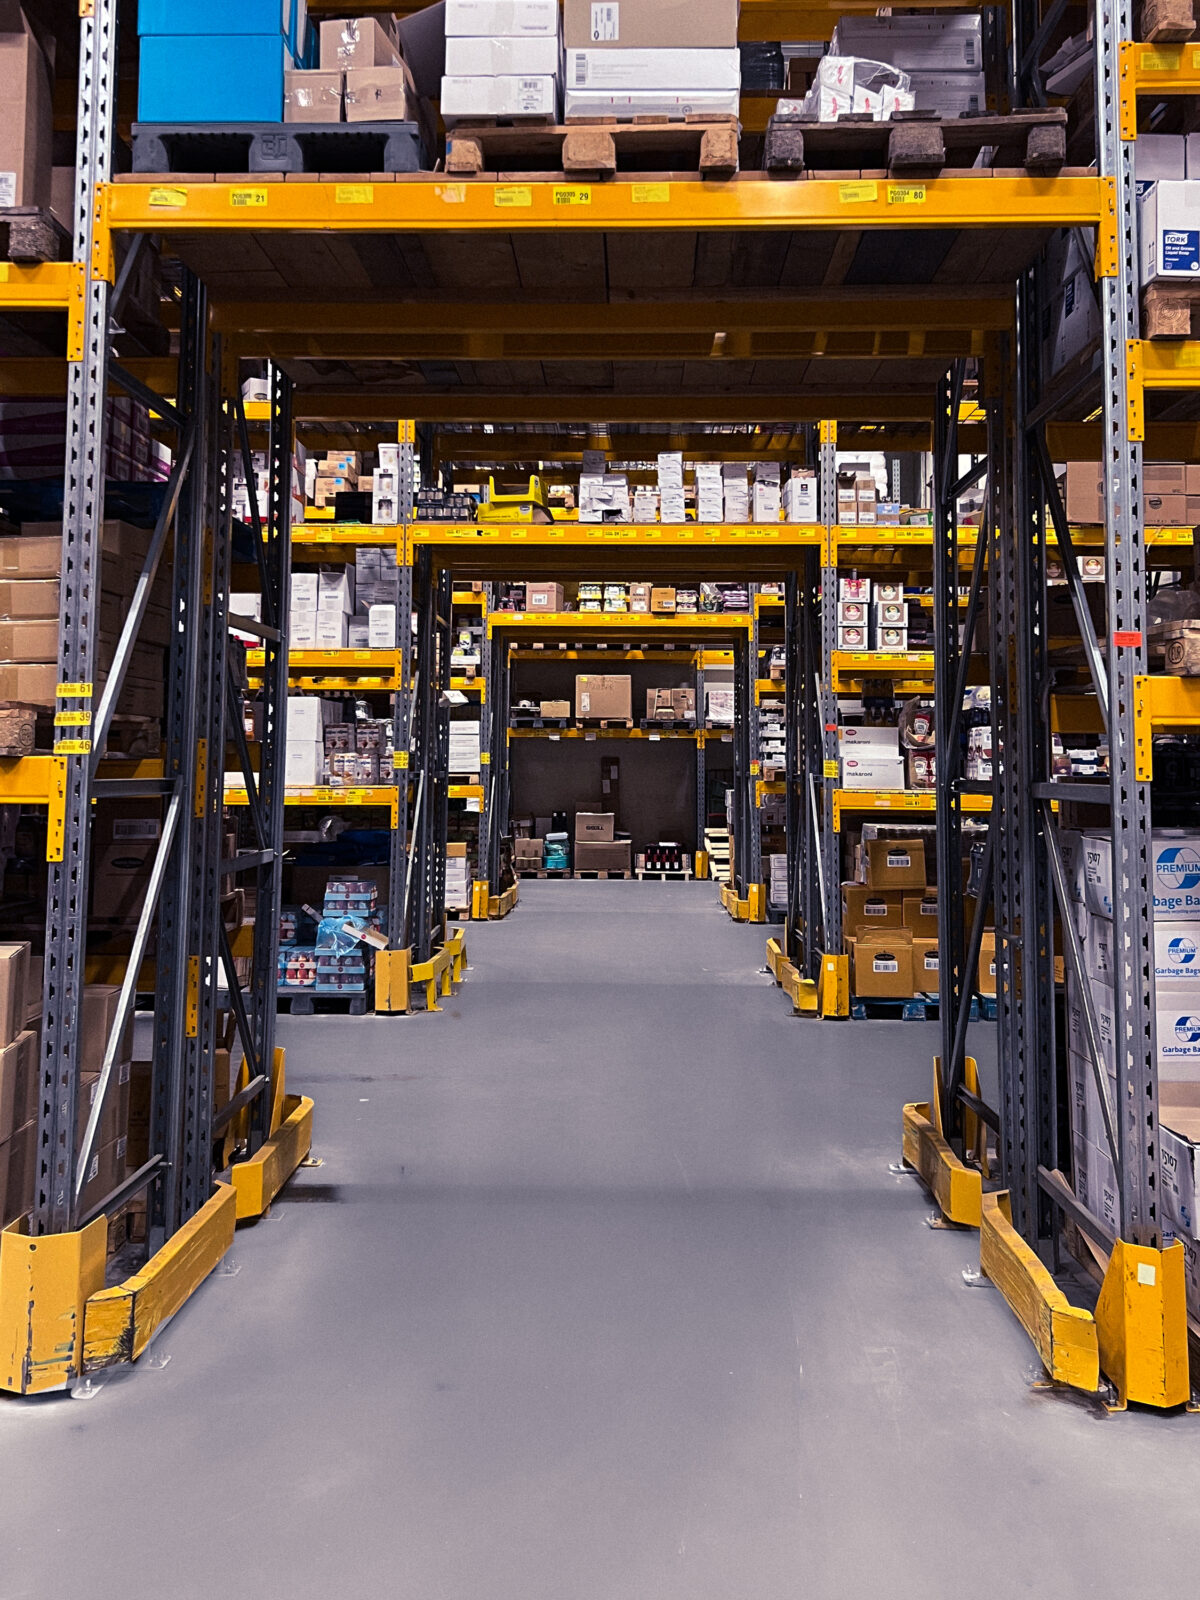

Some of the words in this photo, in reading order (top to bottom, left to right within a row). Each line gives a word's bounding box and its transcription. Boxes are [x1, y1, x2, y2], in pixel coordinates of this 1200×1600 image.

[255, 194, 265, 203] 21
[579, 192, 589, 201] 29
[913, 191, 924, 199] 80
[80, 712, 91, 722] 39
[79, 741, 90, 751] 46
[1155, 967, 1184, 976] Garbage
[1162, 1046, 1191, 1055] Garbage
